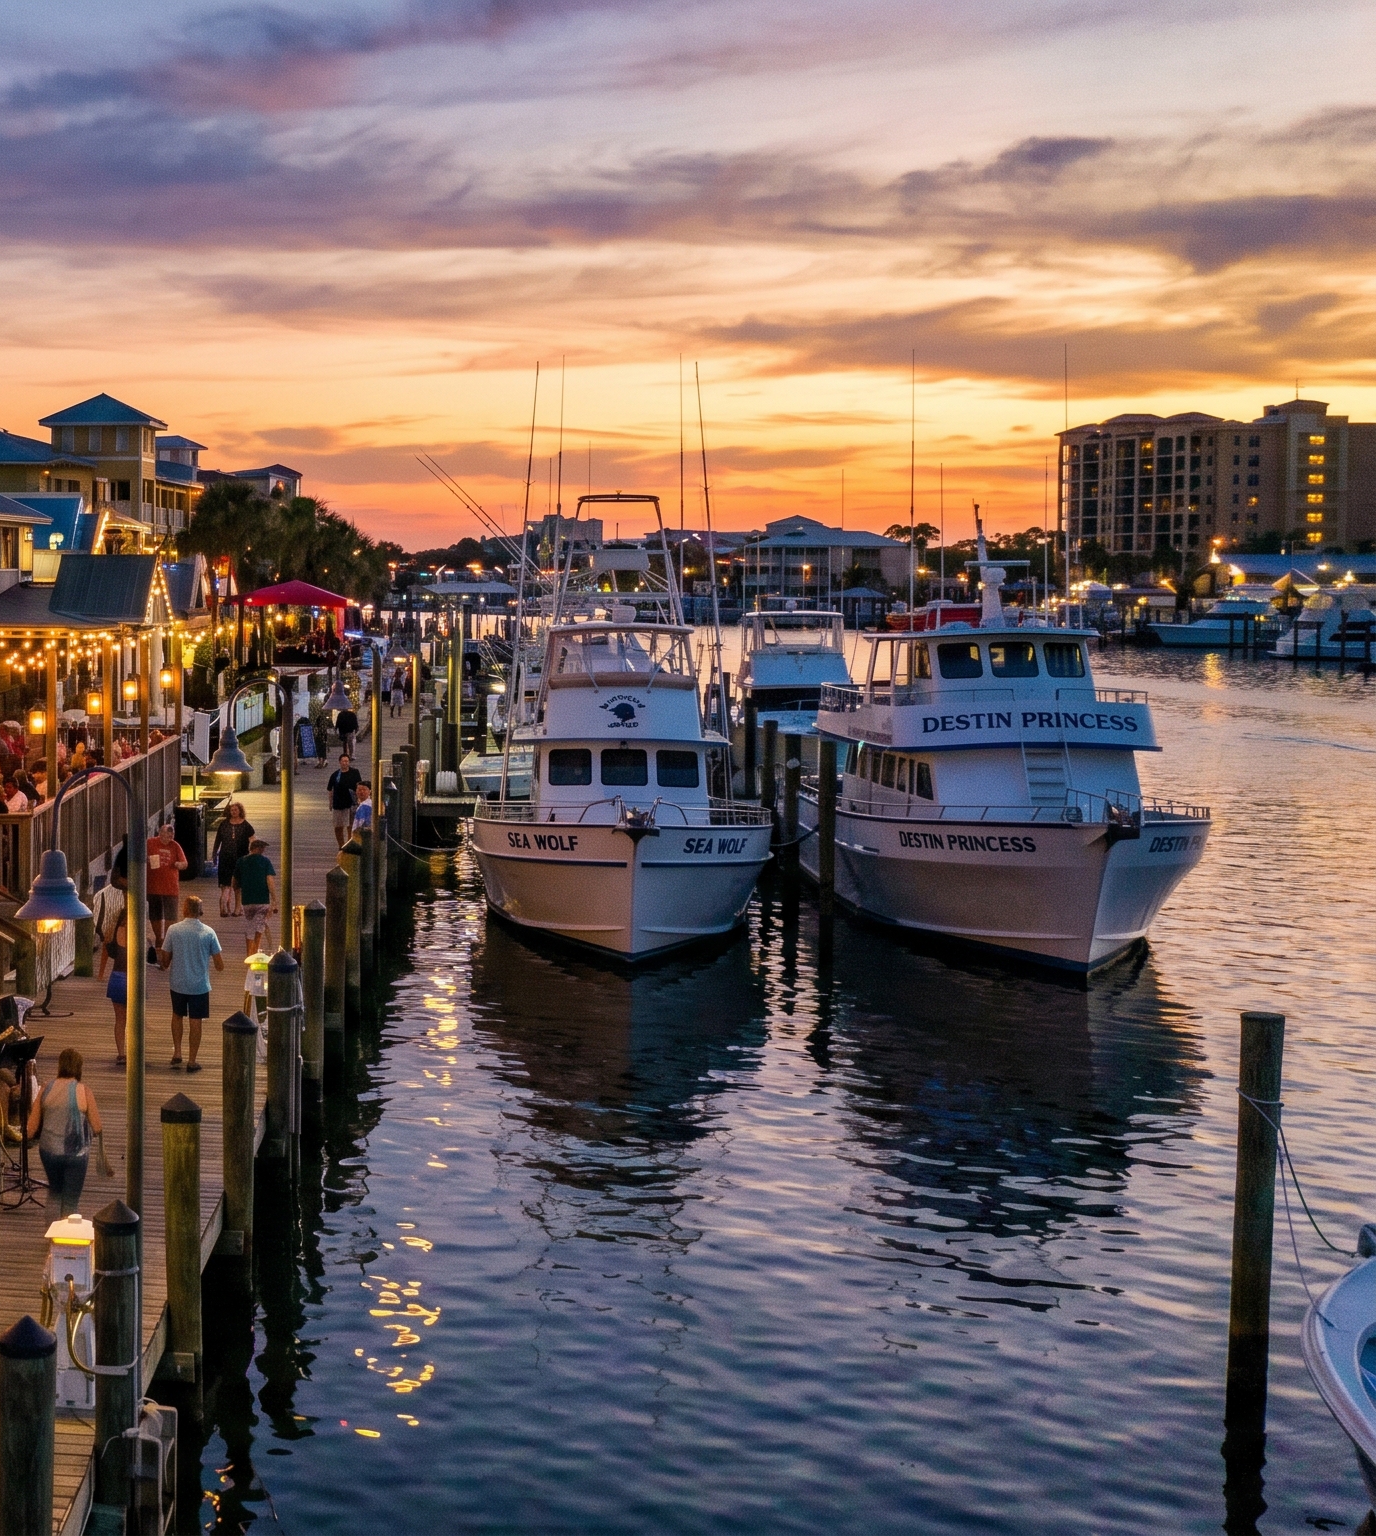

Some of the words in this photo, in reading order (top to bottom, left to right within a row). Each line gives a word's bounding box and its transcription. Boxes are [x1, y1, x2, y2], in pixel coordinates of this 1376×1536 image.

[922, 711, 1012, 733] DESTIN
[1021, 711, 1138, 732] PRINCESS
[507, 832, 531, 849] SEA
[533, 834, 578, 852] WOLF
[683, 838, 713, 854] SEA
[717, 838, 748, 854] WOLF
[898, 830, 944, 850] DESTIN
[947, 834, 1037, 853] PRINCESS
